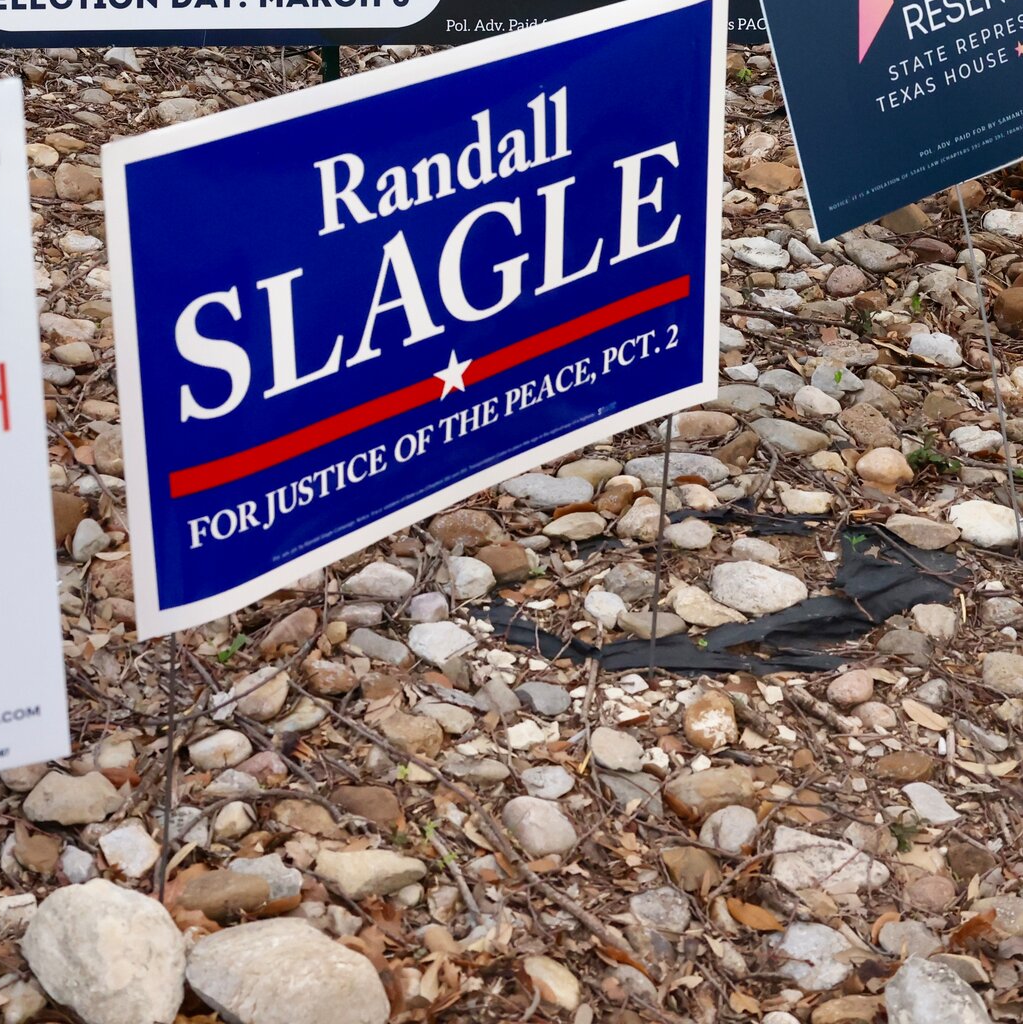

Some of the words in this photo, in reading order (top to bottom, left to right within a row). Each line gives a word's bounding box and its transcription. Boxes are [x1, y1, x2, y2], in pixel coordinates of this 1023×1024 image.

[446, 19, 471, 32] Pol.
[474, 18, 505, 32] Adv.
[888, 45, 948, 81] STATE
[875, 77, 937, 112] TEXAS
[944, 47, 1009, 86] HOUSE
[312, 85, 572, 237] Randall
[173, 141, 682, 424] SLAGLE
[186, 500, 261, 550] FOR
[262, 444, 387, 530] JUSTICE
[393, 426, 434, 464] OF
[437, 397, 500, 445] THE
[504, 358, 598, 418] PEACE,
[601, 332, 661, 378] PCT.
[666, 323, 679, 350] 2
